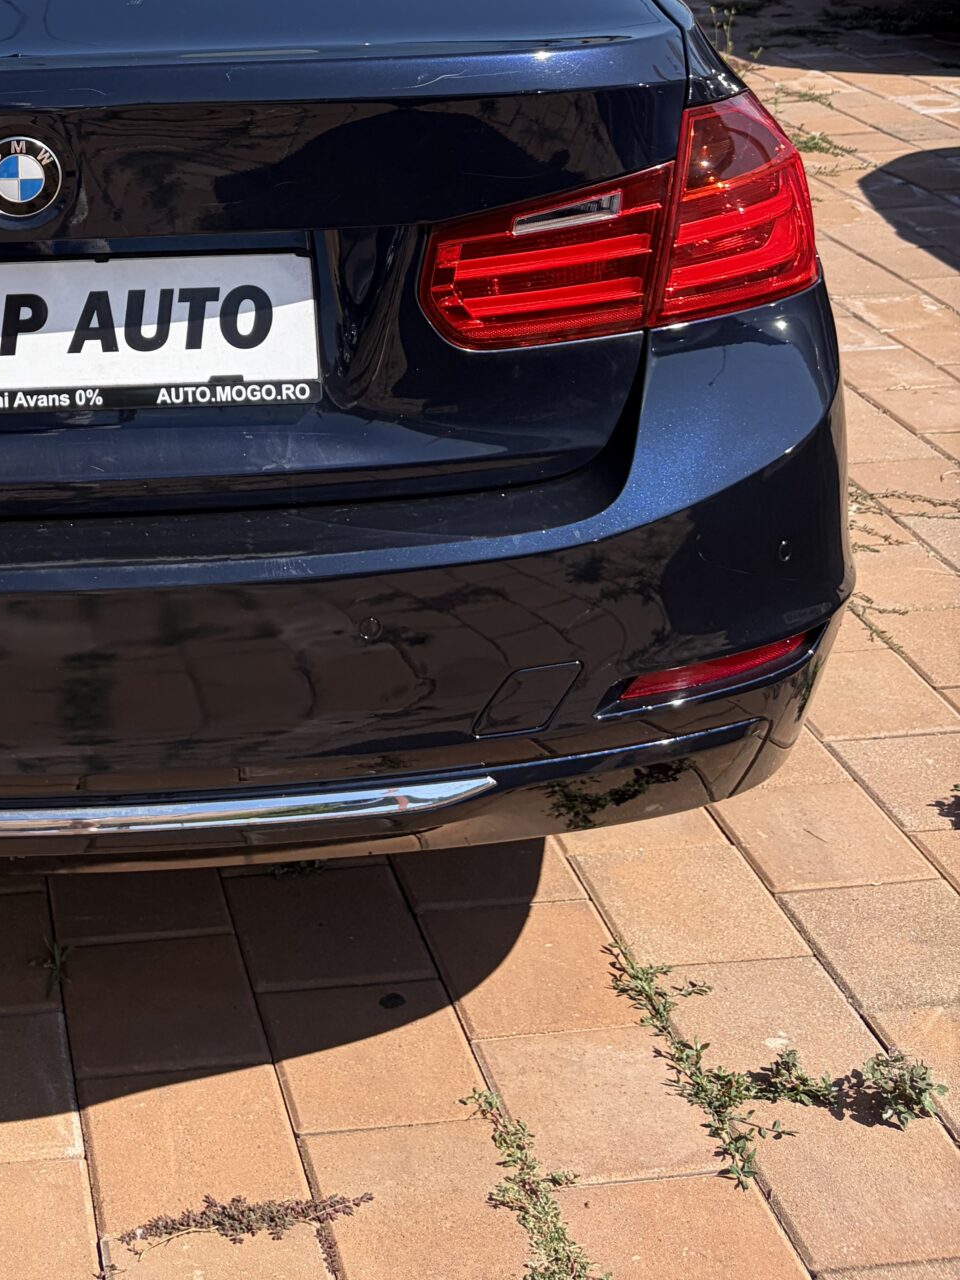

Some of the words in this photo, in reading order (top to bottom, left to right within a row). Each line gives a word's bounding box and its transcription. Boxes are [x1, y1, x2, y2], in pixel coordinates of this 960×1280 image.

[67, 284, 273, 354] AUTO
[13, 391, 71, 408] Avans
[75, 388, 103, 406] 0%
[156, 383, 311, 405] AUTO.MOGO.RO
